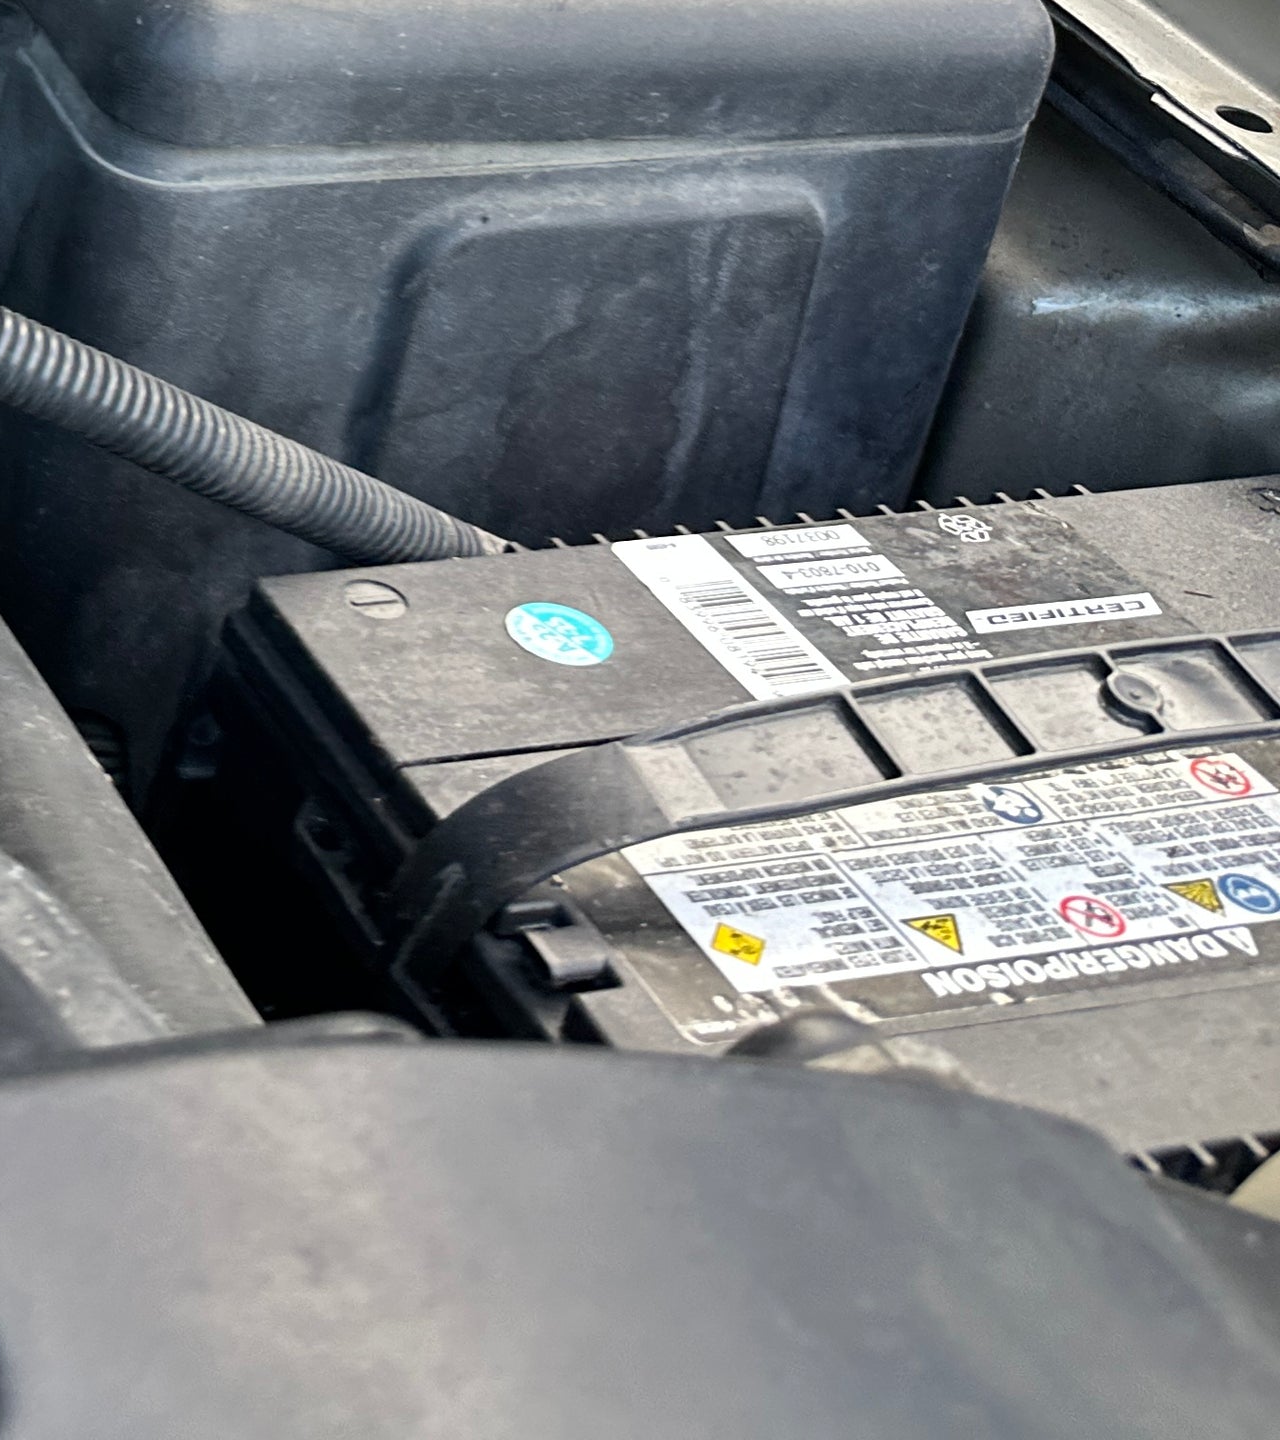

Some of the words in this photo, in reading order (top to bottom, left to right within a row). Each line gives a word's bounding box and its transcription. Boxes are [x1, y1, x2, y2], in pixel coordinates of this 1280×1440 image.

[760, 530, 840, 546] 0037198
[781, 561, 881, 580] 010-7803-4
[987, 600, 1146, 626] CERTIFIED
[922, 934, 1229, 997] DANGER/POISON
